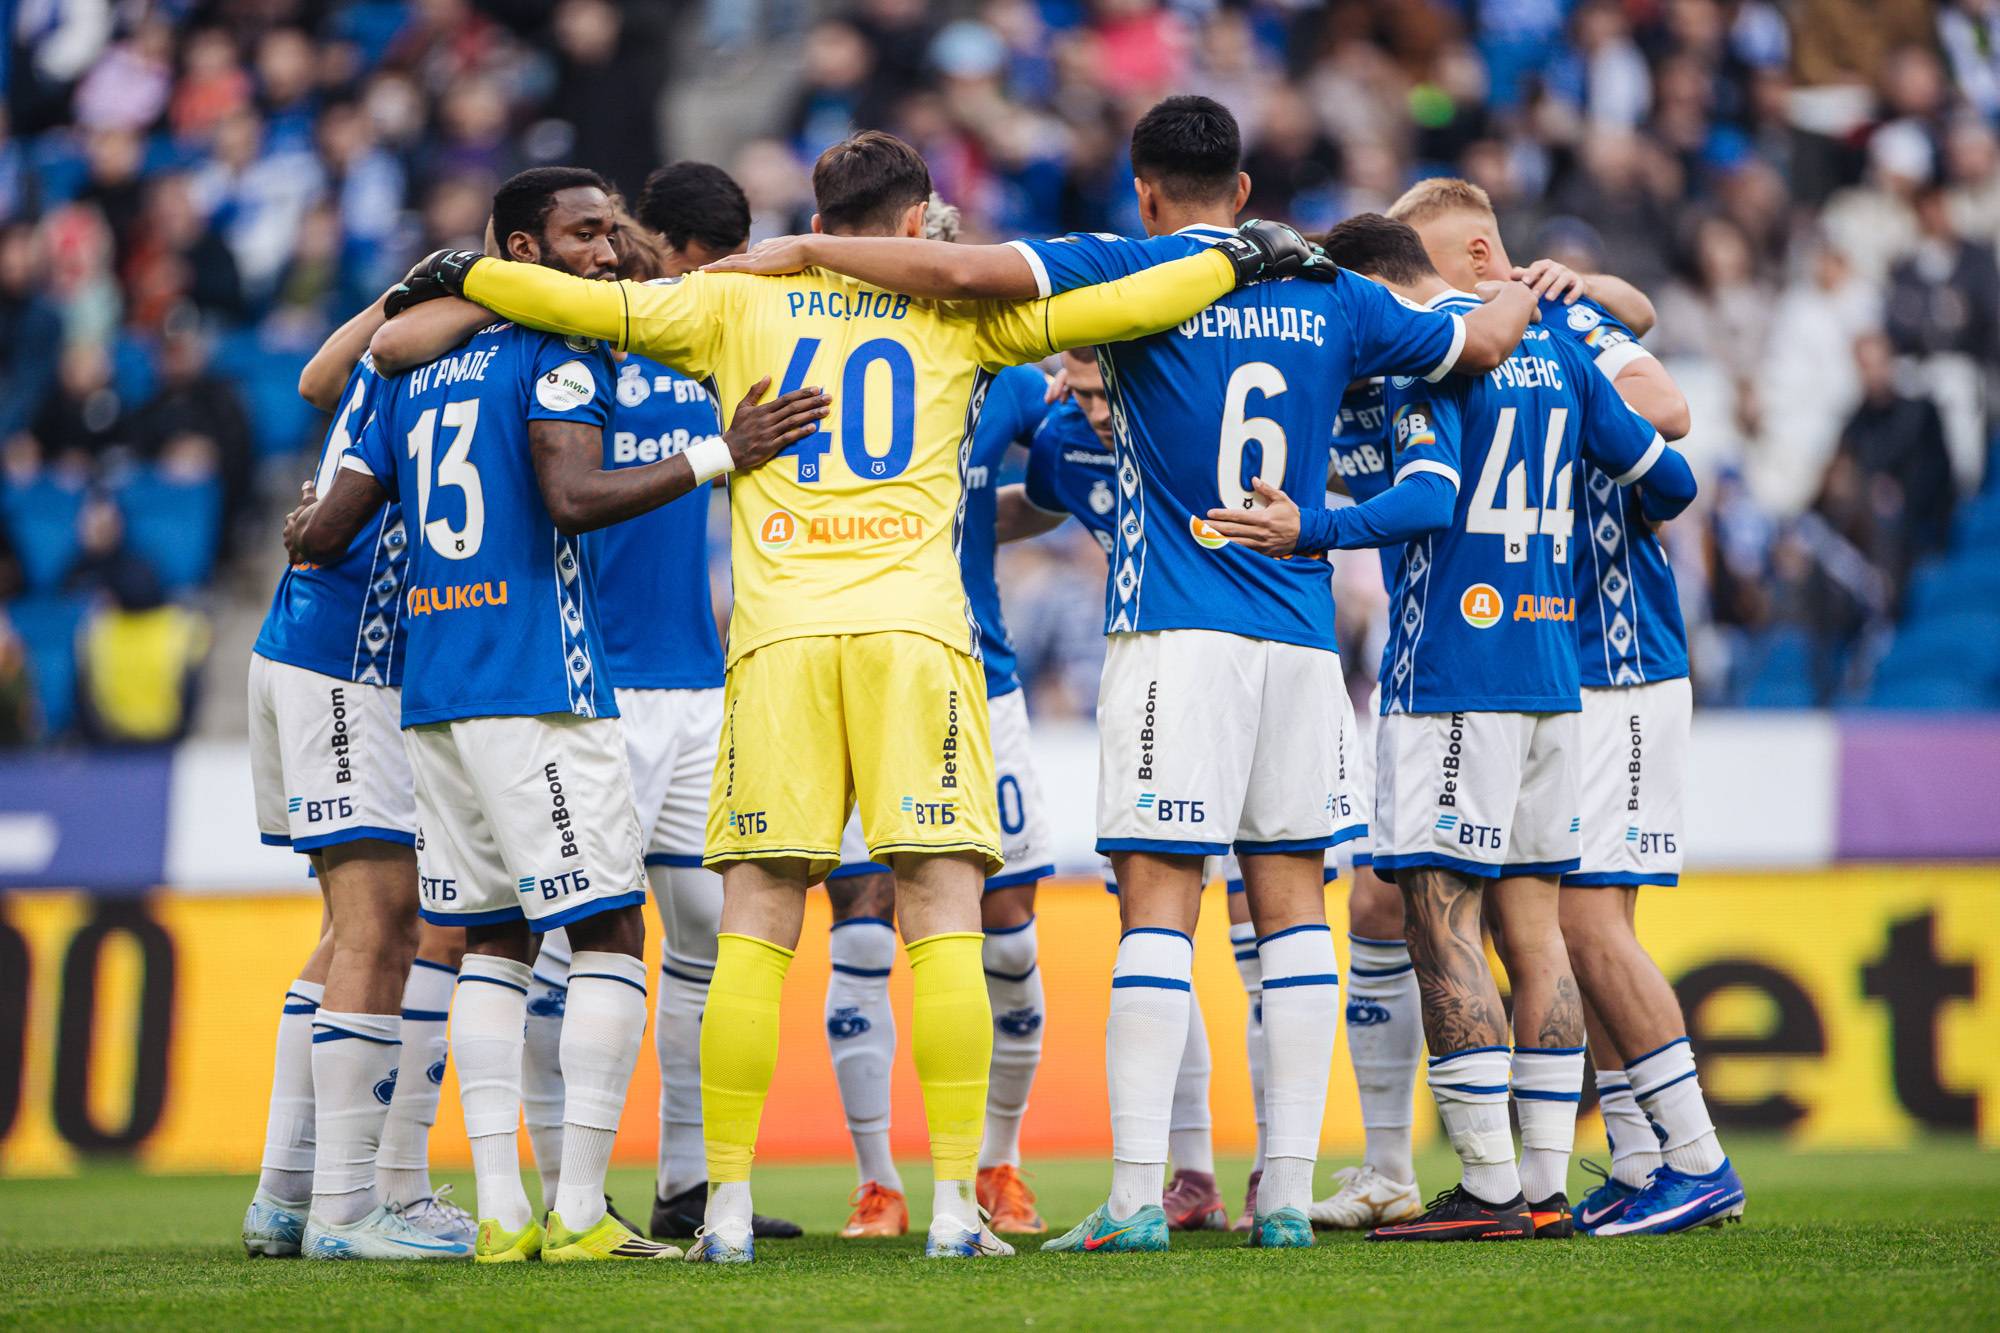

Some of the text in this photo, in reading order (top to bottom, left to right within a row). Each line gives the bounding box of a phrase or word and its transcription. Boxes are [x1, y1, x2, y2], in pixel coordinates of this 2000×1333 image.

[1178, 305, 1327, 347] ФЕРНАНДЕС
[409, 345, 499, 399] НГАМАЛЁ
[1490, 356, 1563, 390] РУБЕНС
[773, 338, 916, 483] 40
[1356, 405, 1385, 430] ВТ
[1398, 413, 1428, 443] BB
[614, 428, 720, 463] BetB
[1217, 361, 1288, 511] 6
[407, 398, 484, 560] 13
[1466, 407, 1574, 564] 44
[331, 687, 352, 784] BetBoom
[941, 690, 957, 788] BetBoom
[1138, 681, 1157, 781] BetBoom
[1439, 711, 1464, 807] BetBoom
[1628, 715, 1642, 811] BetBoom
[307, 796, 353, 823] ВТБ
[544, 762, 579, 859] BetBoom
[736, 811, 768, 836] ВТБ
[915, 803, 956, 825] ВТБ
[1157, 799, 1205, 823] ВТБ
[1459, 823, 1501, 849] ВТБ
[1640, 833, 1677, 854] ВТБ
[540, 868, 590, 901] ВТБ
[0, 890, 175, 1147] 0
